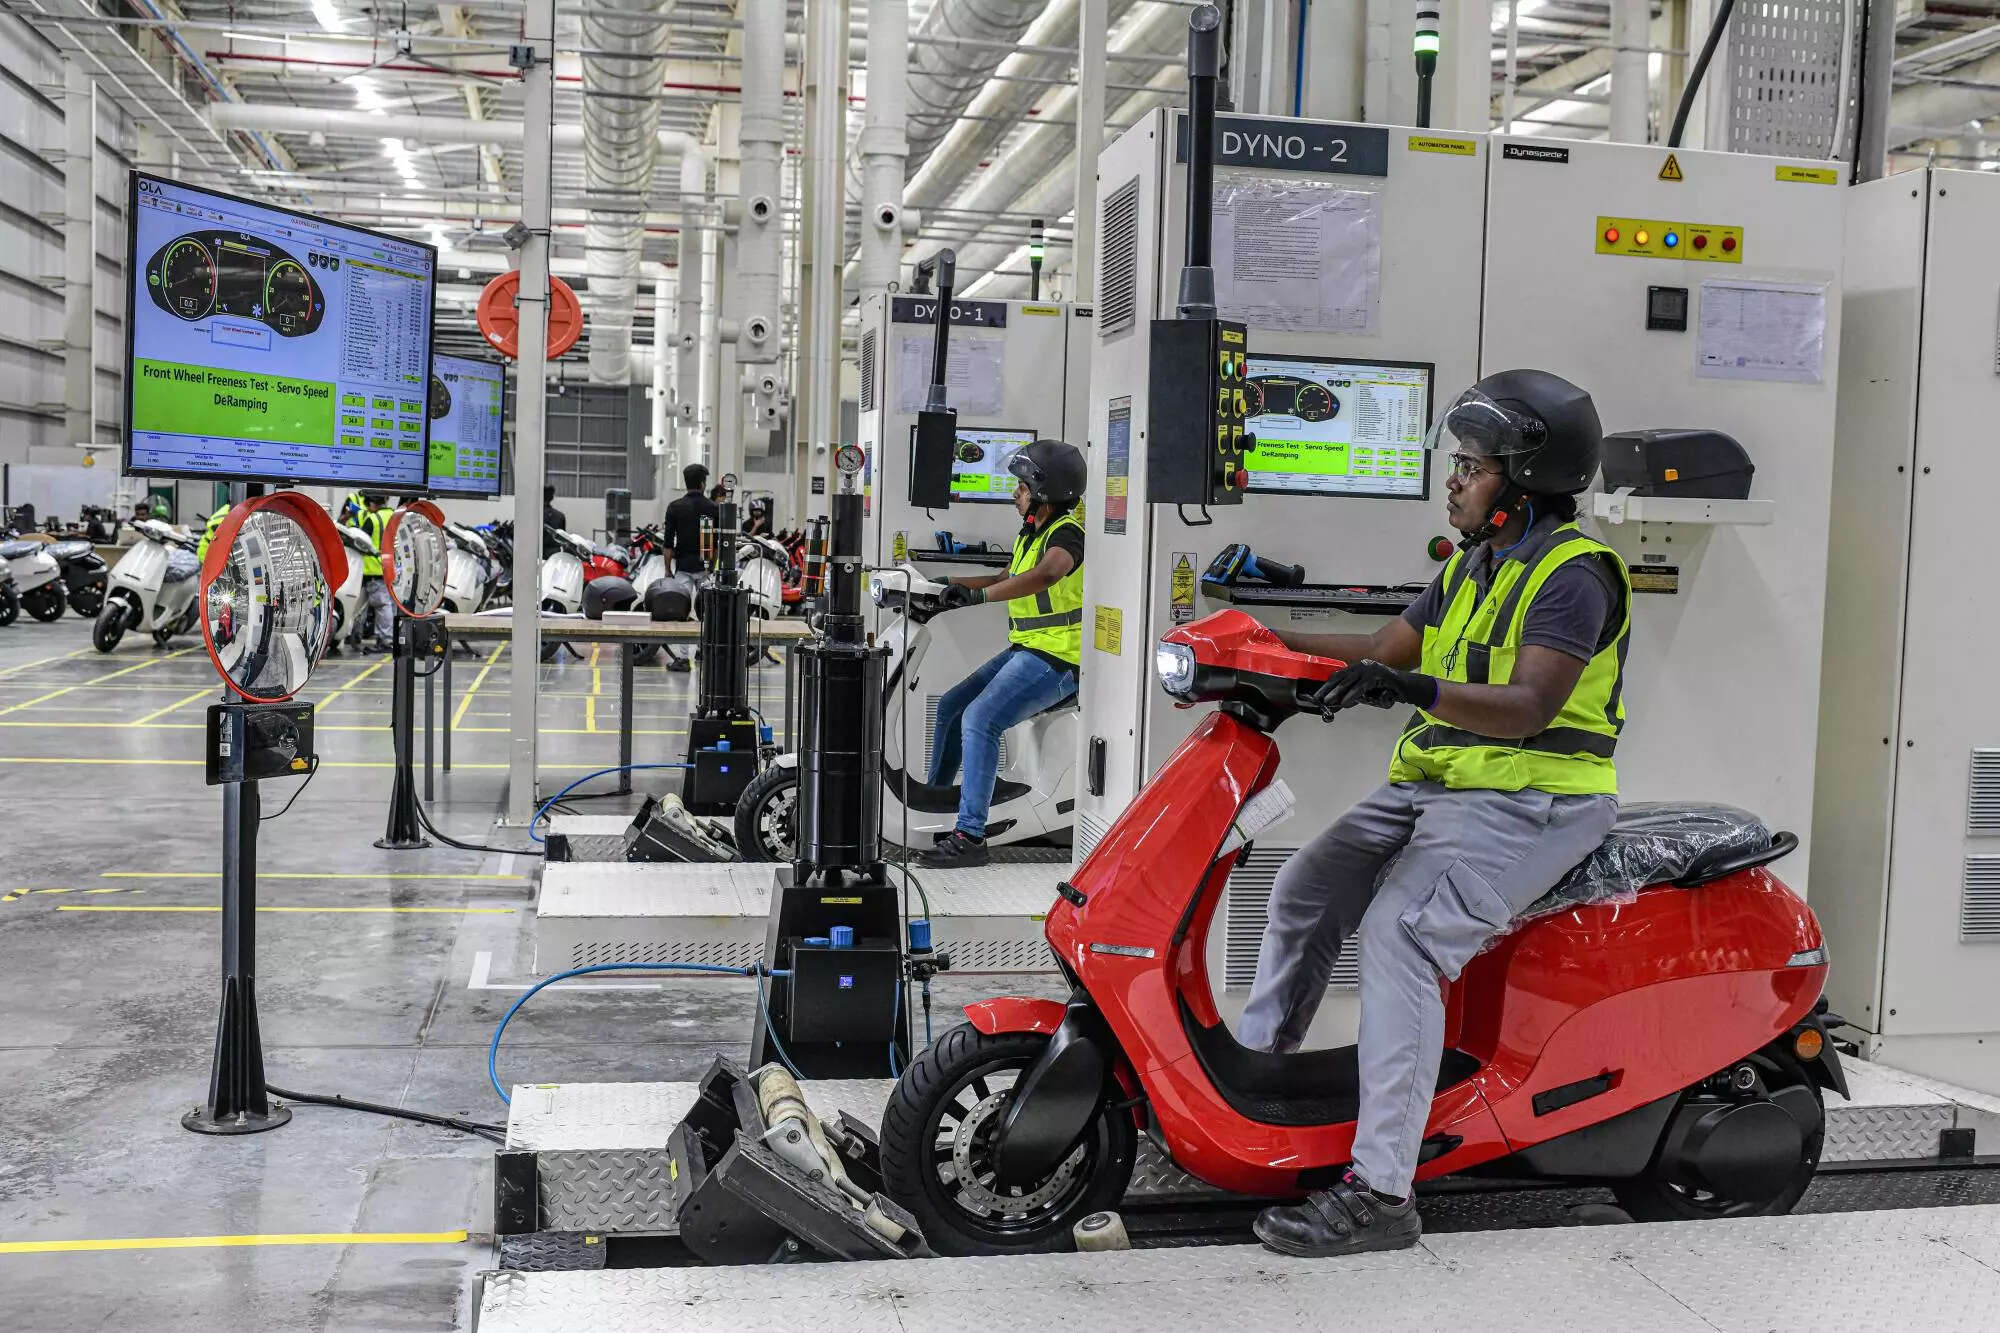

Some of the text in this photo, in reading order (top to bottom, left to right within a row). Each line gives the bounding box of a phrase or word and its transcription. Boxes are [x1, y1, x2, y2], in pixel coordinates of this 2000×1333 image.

[1222, 131, 1306, 160] DYNO
[1330, 139, 1348, 163] 2
[1418, 141, 1450, 150] AUTOMATION
[1510, 147, 1563, 159] Dynaspede
[139, 181, 163, 196] OLA
[914, 304, 961, 320] DYO
[975, 307, 984, 322] 1
[143, 364, 171, 381] Front
[173, 368, 205, 384] Wheel
[207, 372, 248, 389] Freeness
[250, 378, 269, 392] Test
[276, 382, 301, 395] Servo
[303, 385, 329, 400] Speed
[214, 394, 268, 414] DeRamping
[1257, 441, 1284, 450] Freeness
[1324, 444, 1344, 452] Speed
[1262, 451, 1299, 460] DeRamping
